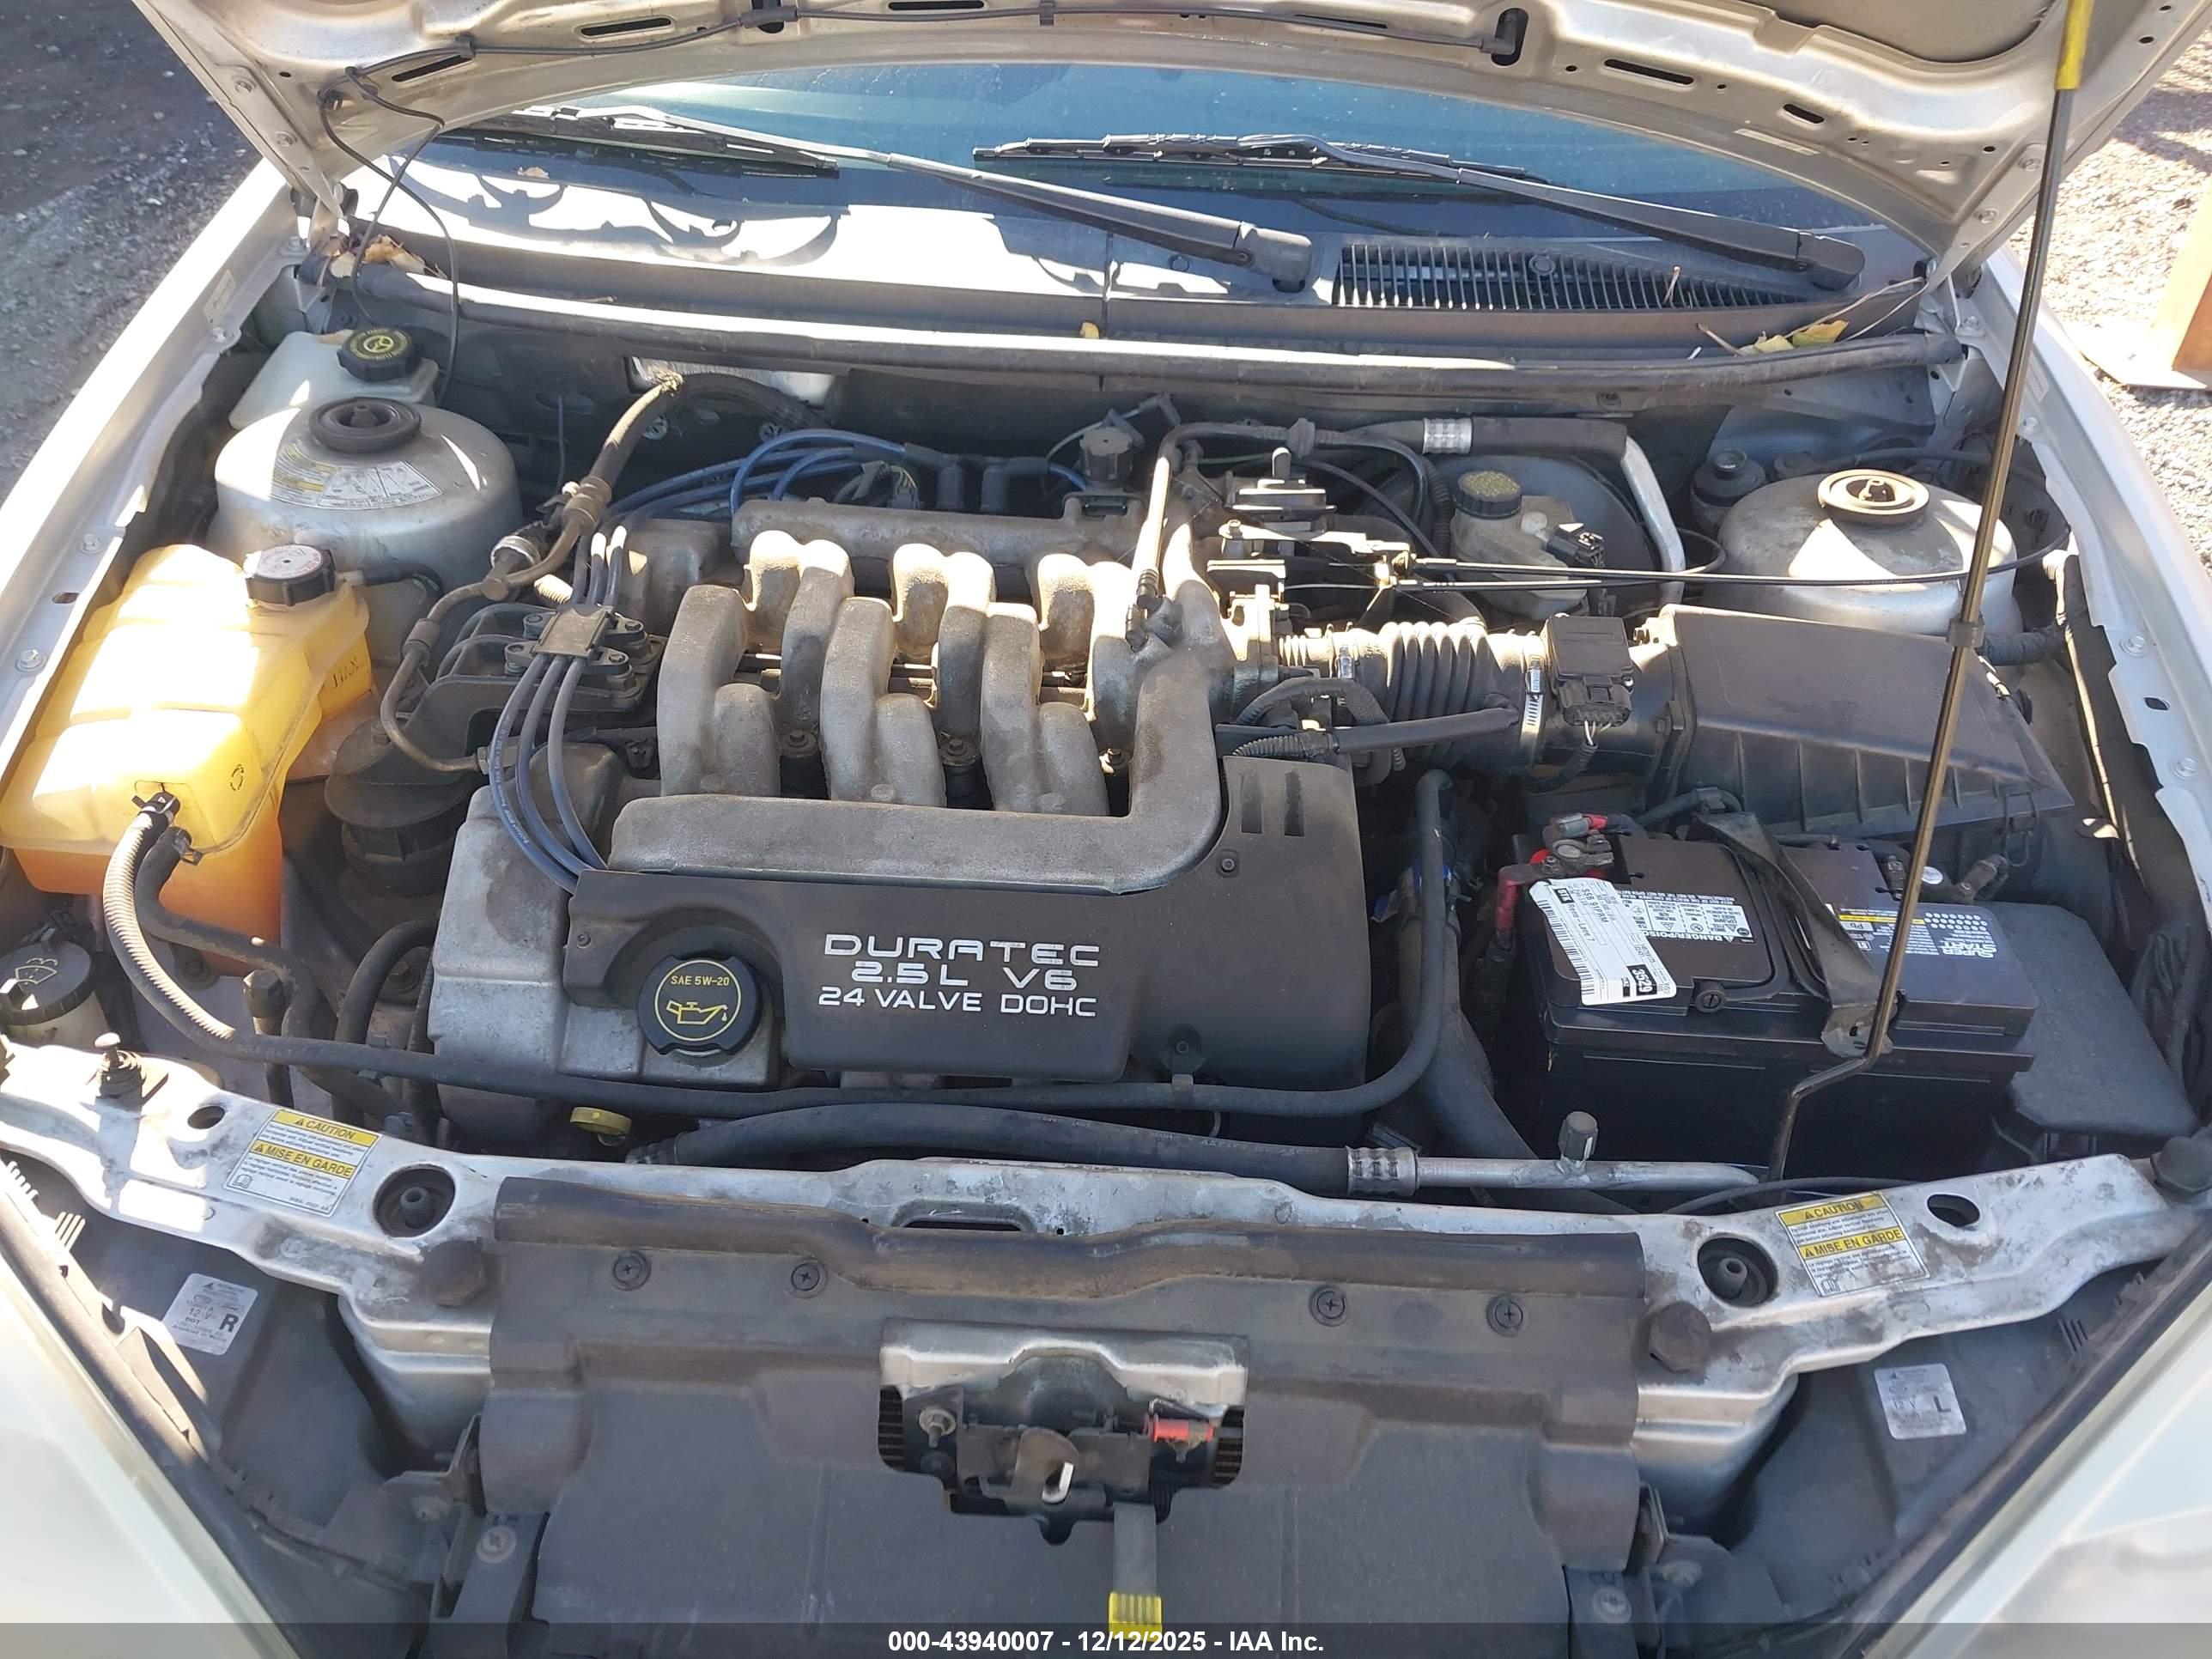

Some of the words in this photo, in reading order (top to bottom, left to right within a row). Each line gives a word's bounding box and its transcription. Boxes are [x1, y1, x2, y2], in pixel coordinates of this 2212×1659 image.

[1578, 923, 1590, 937] Lane
[824, 933, 1100, 967] DURATEC
[1942, 947, 1994, 957] SUPER
[1944, 941, 1998, 953] START
[671, 975, 692, 986] SAE
[694, 975, 730, 986] 5W-20
[1002, 967, 1077, 991] V6
[1632, 969, 1653, 993] 3529
[818, 987, 866, 1007] 24
[874, 988, 982, 1012] VALVE
[1000, 994, 1097, 1018] DOHC
[306, 1121, 356, 1139] CAUTION
[265, 1145, 293, 1159] MISE
[294, 1154, 311, 1164] EN
[313, 1158, 353, 1177] GARDE
[1814, 1200, 1864, 1217] CAUTION
[1814, 1243, 1842, 1255] MISE
[1844, 1238, 1860, 1249] EN
[1862, 1230, 1901, 1244] GARDE
[188, 1308, 201, 1317] 12
[219, 1314, 239, 1333] R
[1934, 1396, 1952, 1413] L
